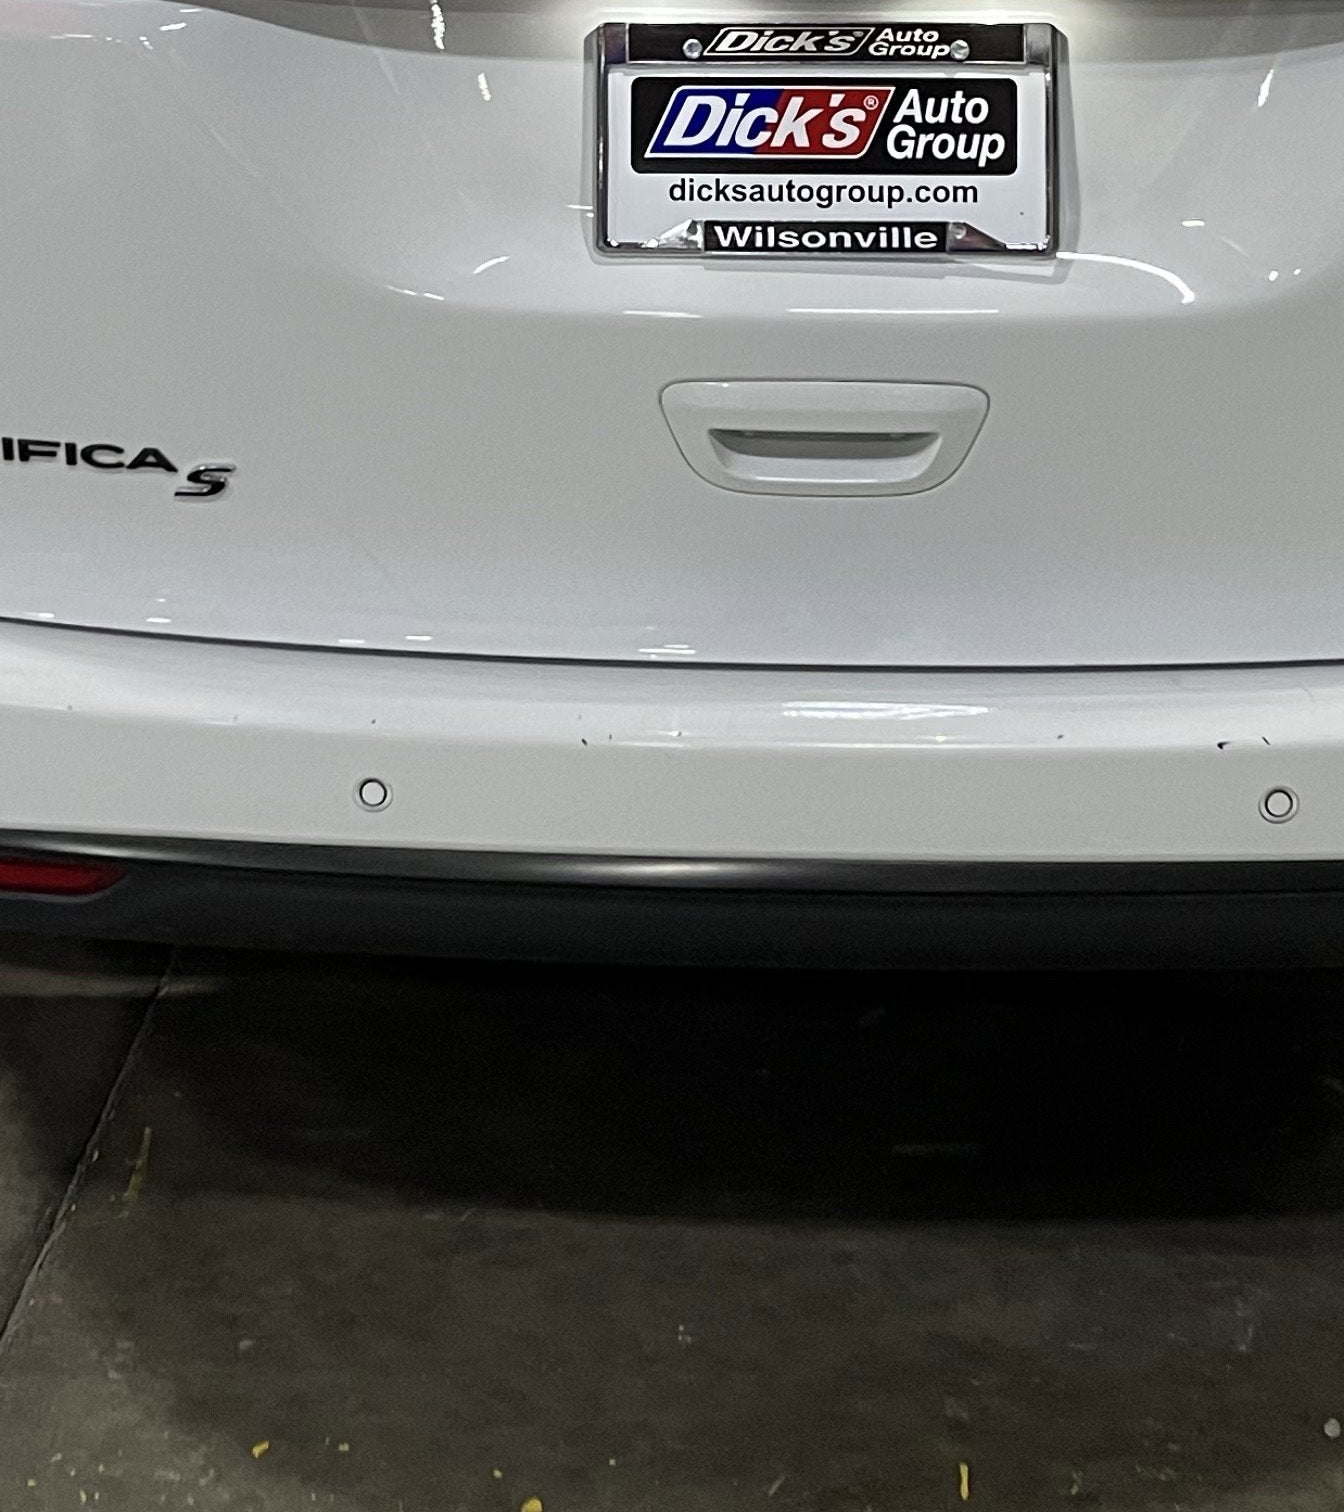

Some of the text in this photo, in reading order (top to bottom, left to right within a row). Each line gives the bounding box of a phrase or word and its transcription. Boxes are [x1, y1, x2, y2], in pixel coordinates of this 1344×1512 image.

[714, 28, 859, 53] Dick's
[868, 42, 952, 59] Group
[875, 28, 940, 43] Auto
[662, 93, 866, 149] Dick's
[892, 89, 990, 125] Auto
[887, 125, 1006, 168] Group
[668, 178, 979, 209] dicksautogroup.com
[714, 226, 939, 249] Wilsonville
[173, 463, 237, 499] S
